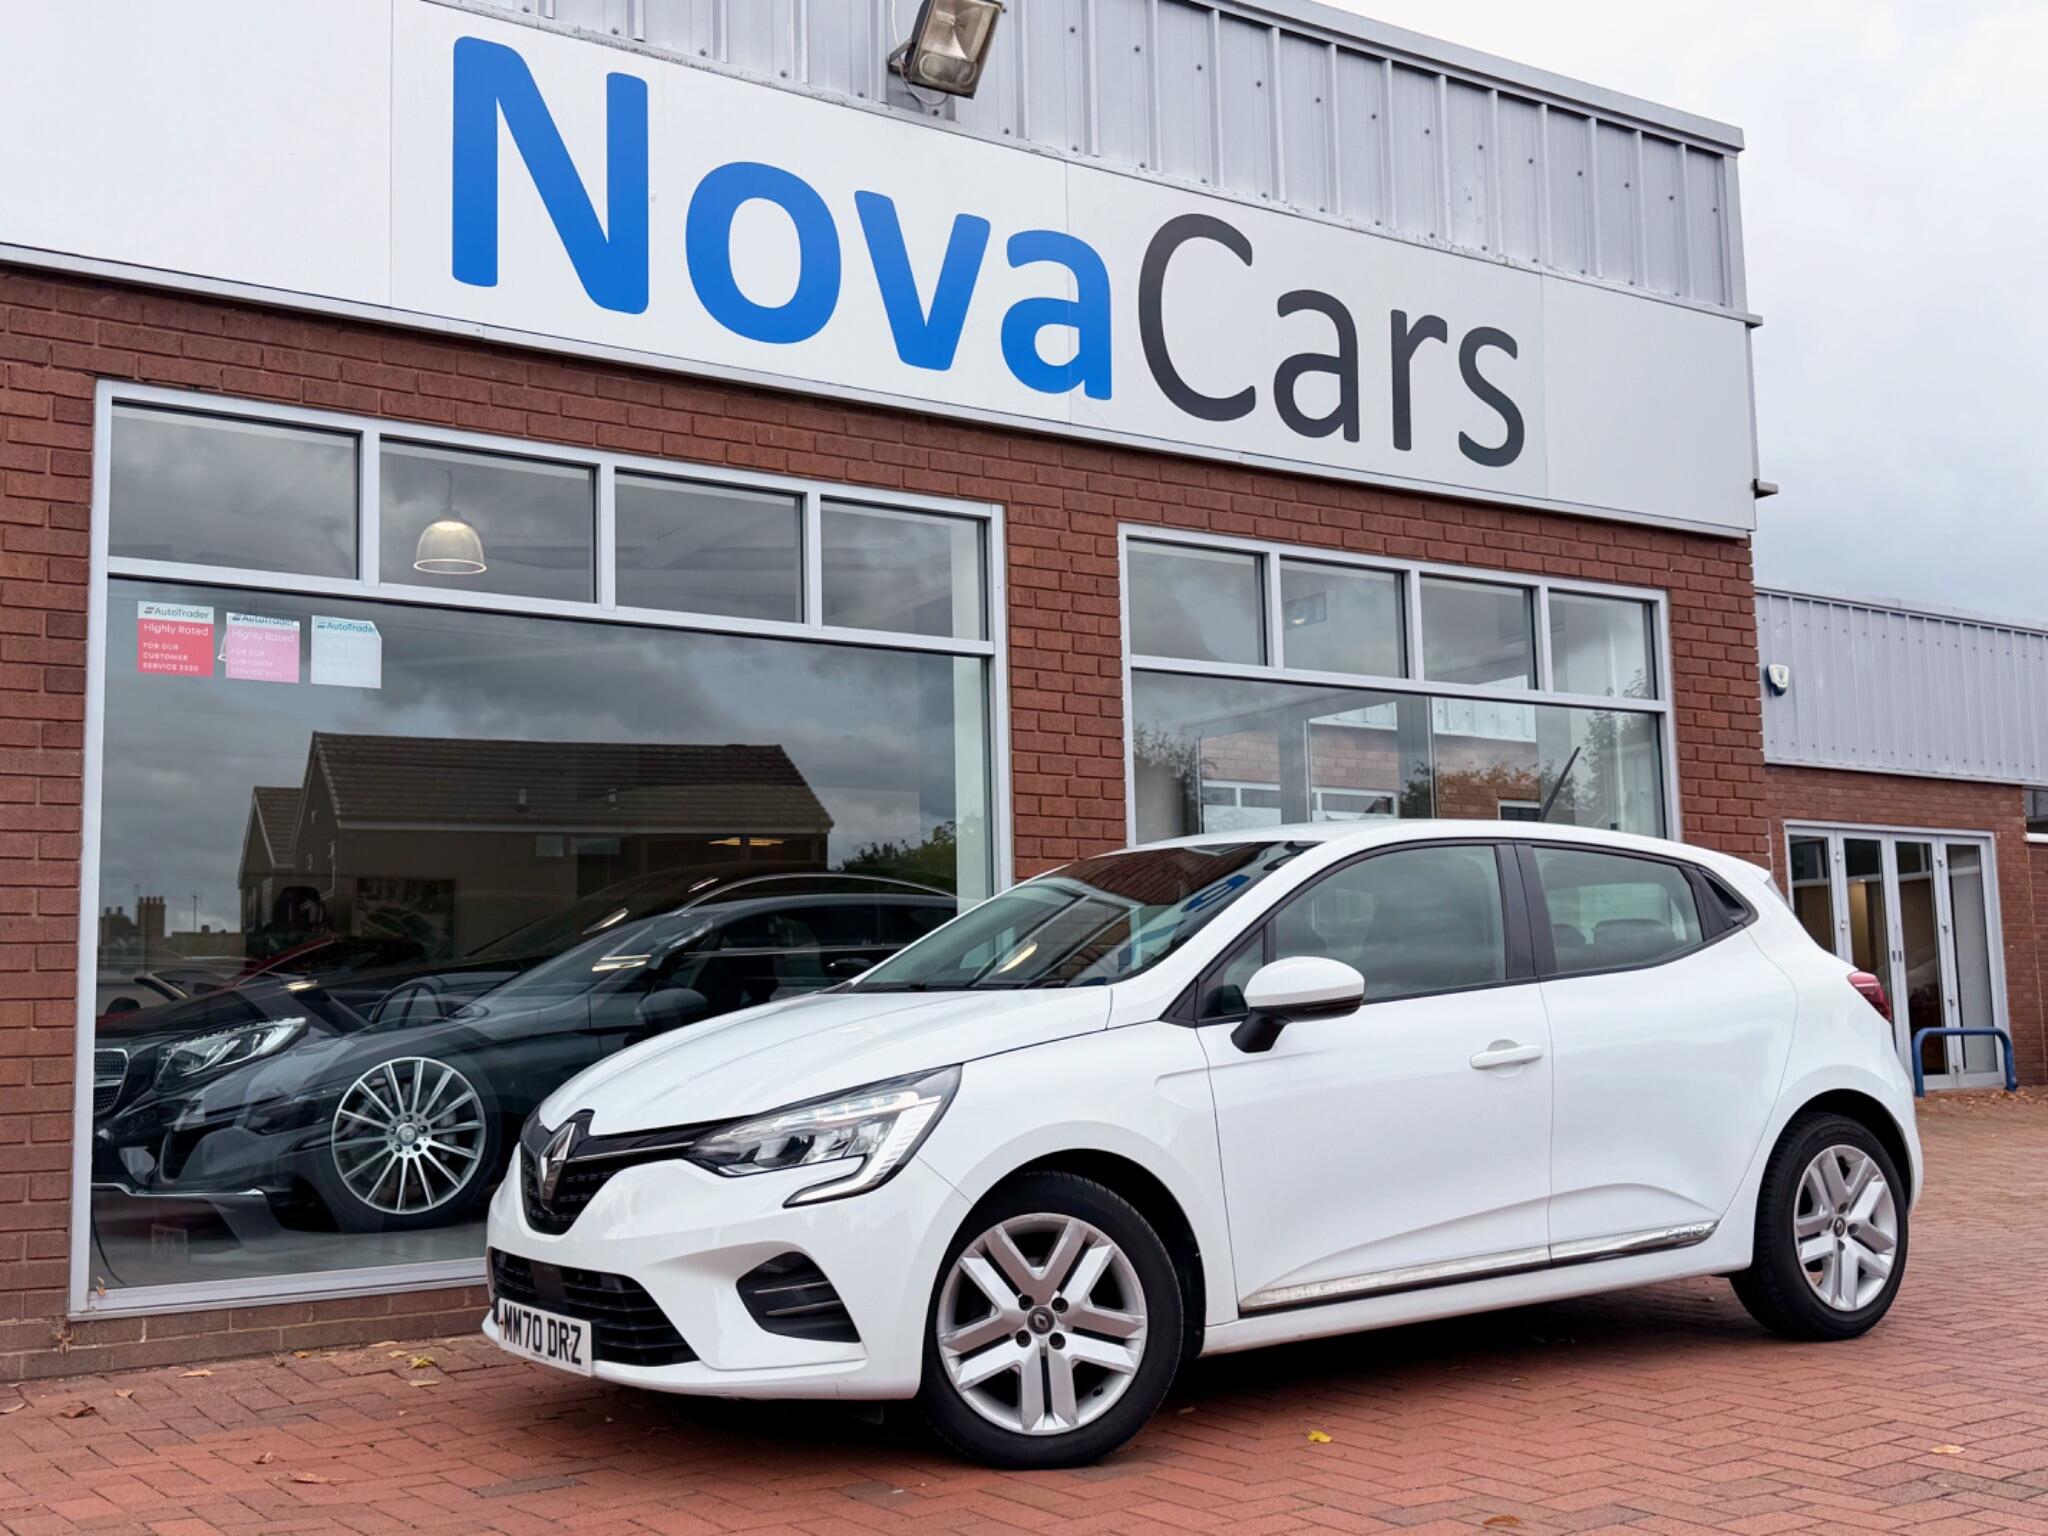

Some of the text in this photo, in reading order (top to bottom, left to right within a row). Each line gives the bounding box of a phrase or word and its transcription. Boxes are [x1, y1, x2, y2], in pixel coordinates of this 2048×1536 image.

[154, 607, 209, 619] AutoTrader
[143, 623, 209, 636] Highly Rated
[326, 621, 376, 634] AutoTrade
[547, 1318, 582, 1366] DRZ
